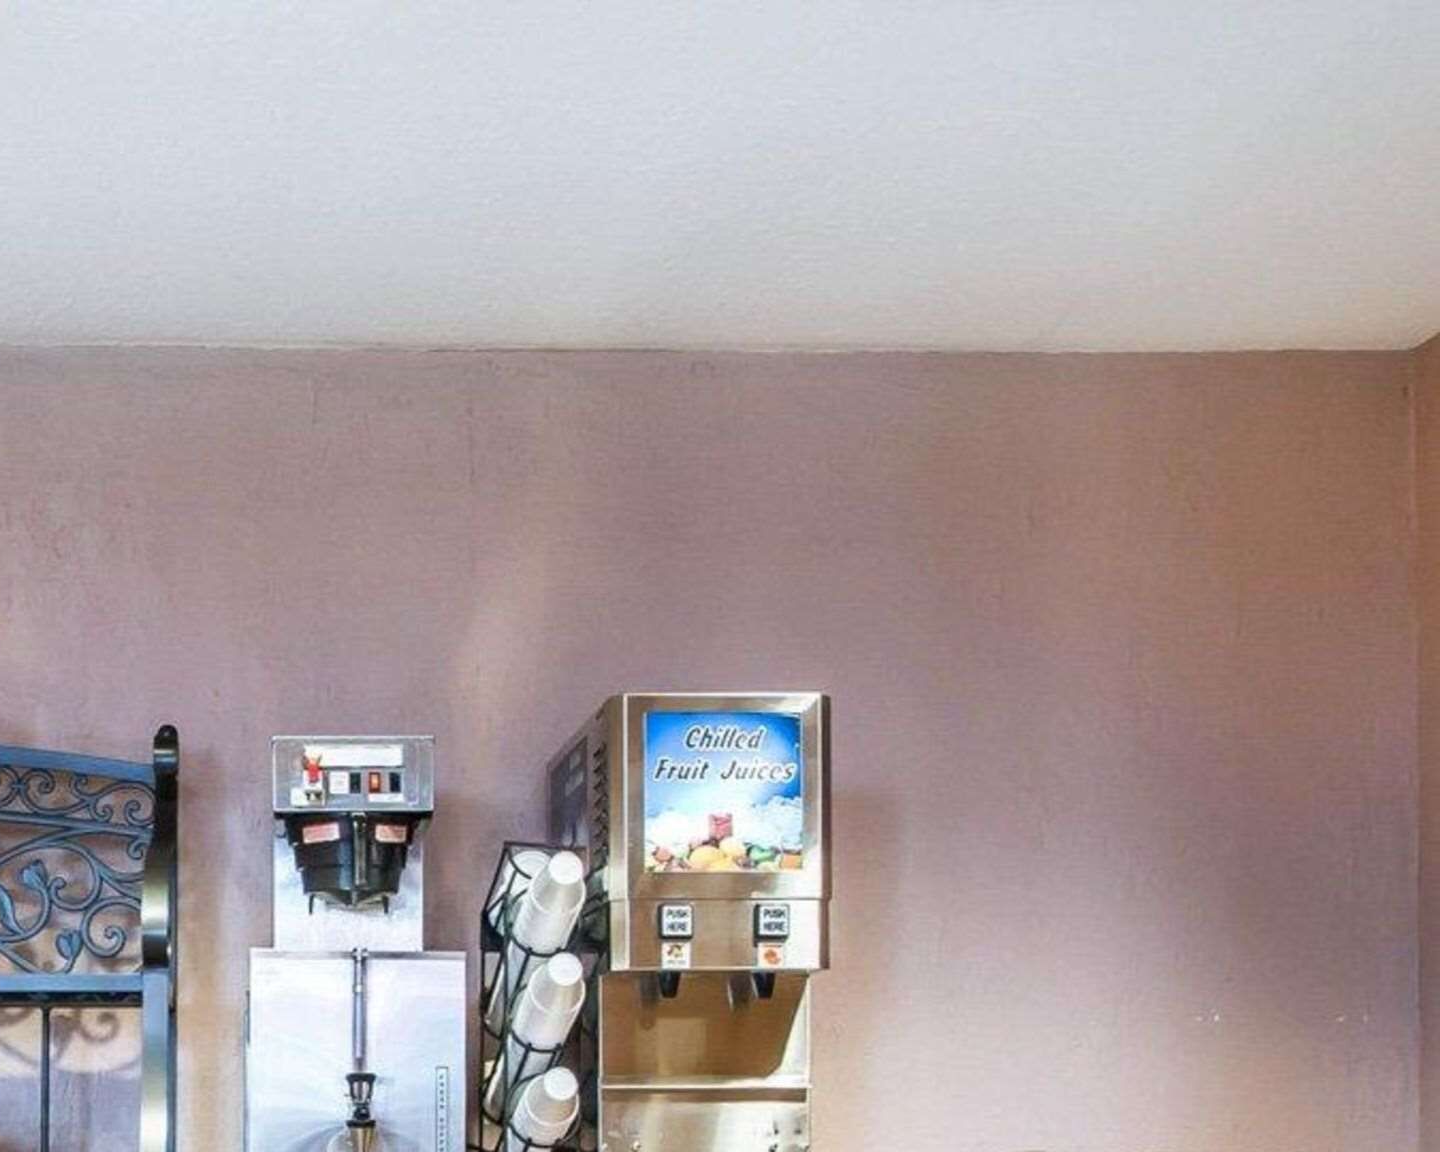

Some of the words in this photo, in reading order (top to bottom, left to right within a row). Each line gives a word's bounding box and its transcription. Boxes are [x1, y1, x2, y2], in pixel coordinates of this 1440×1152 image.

[686, 725, 766, 749] Chilled
[654, 758, 709, 781] Fruit
[720, 759, 795, 781] Juices
[665, 908, 688, 919] PUSH
[763, 908, 786, 919] PUSH
